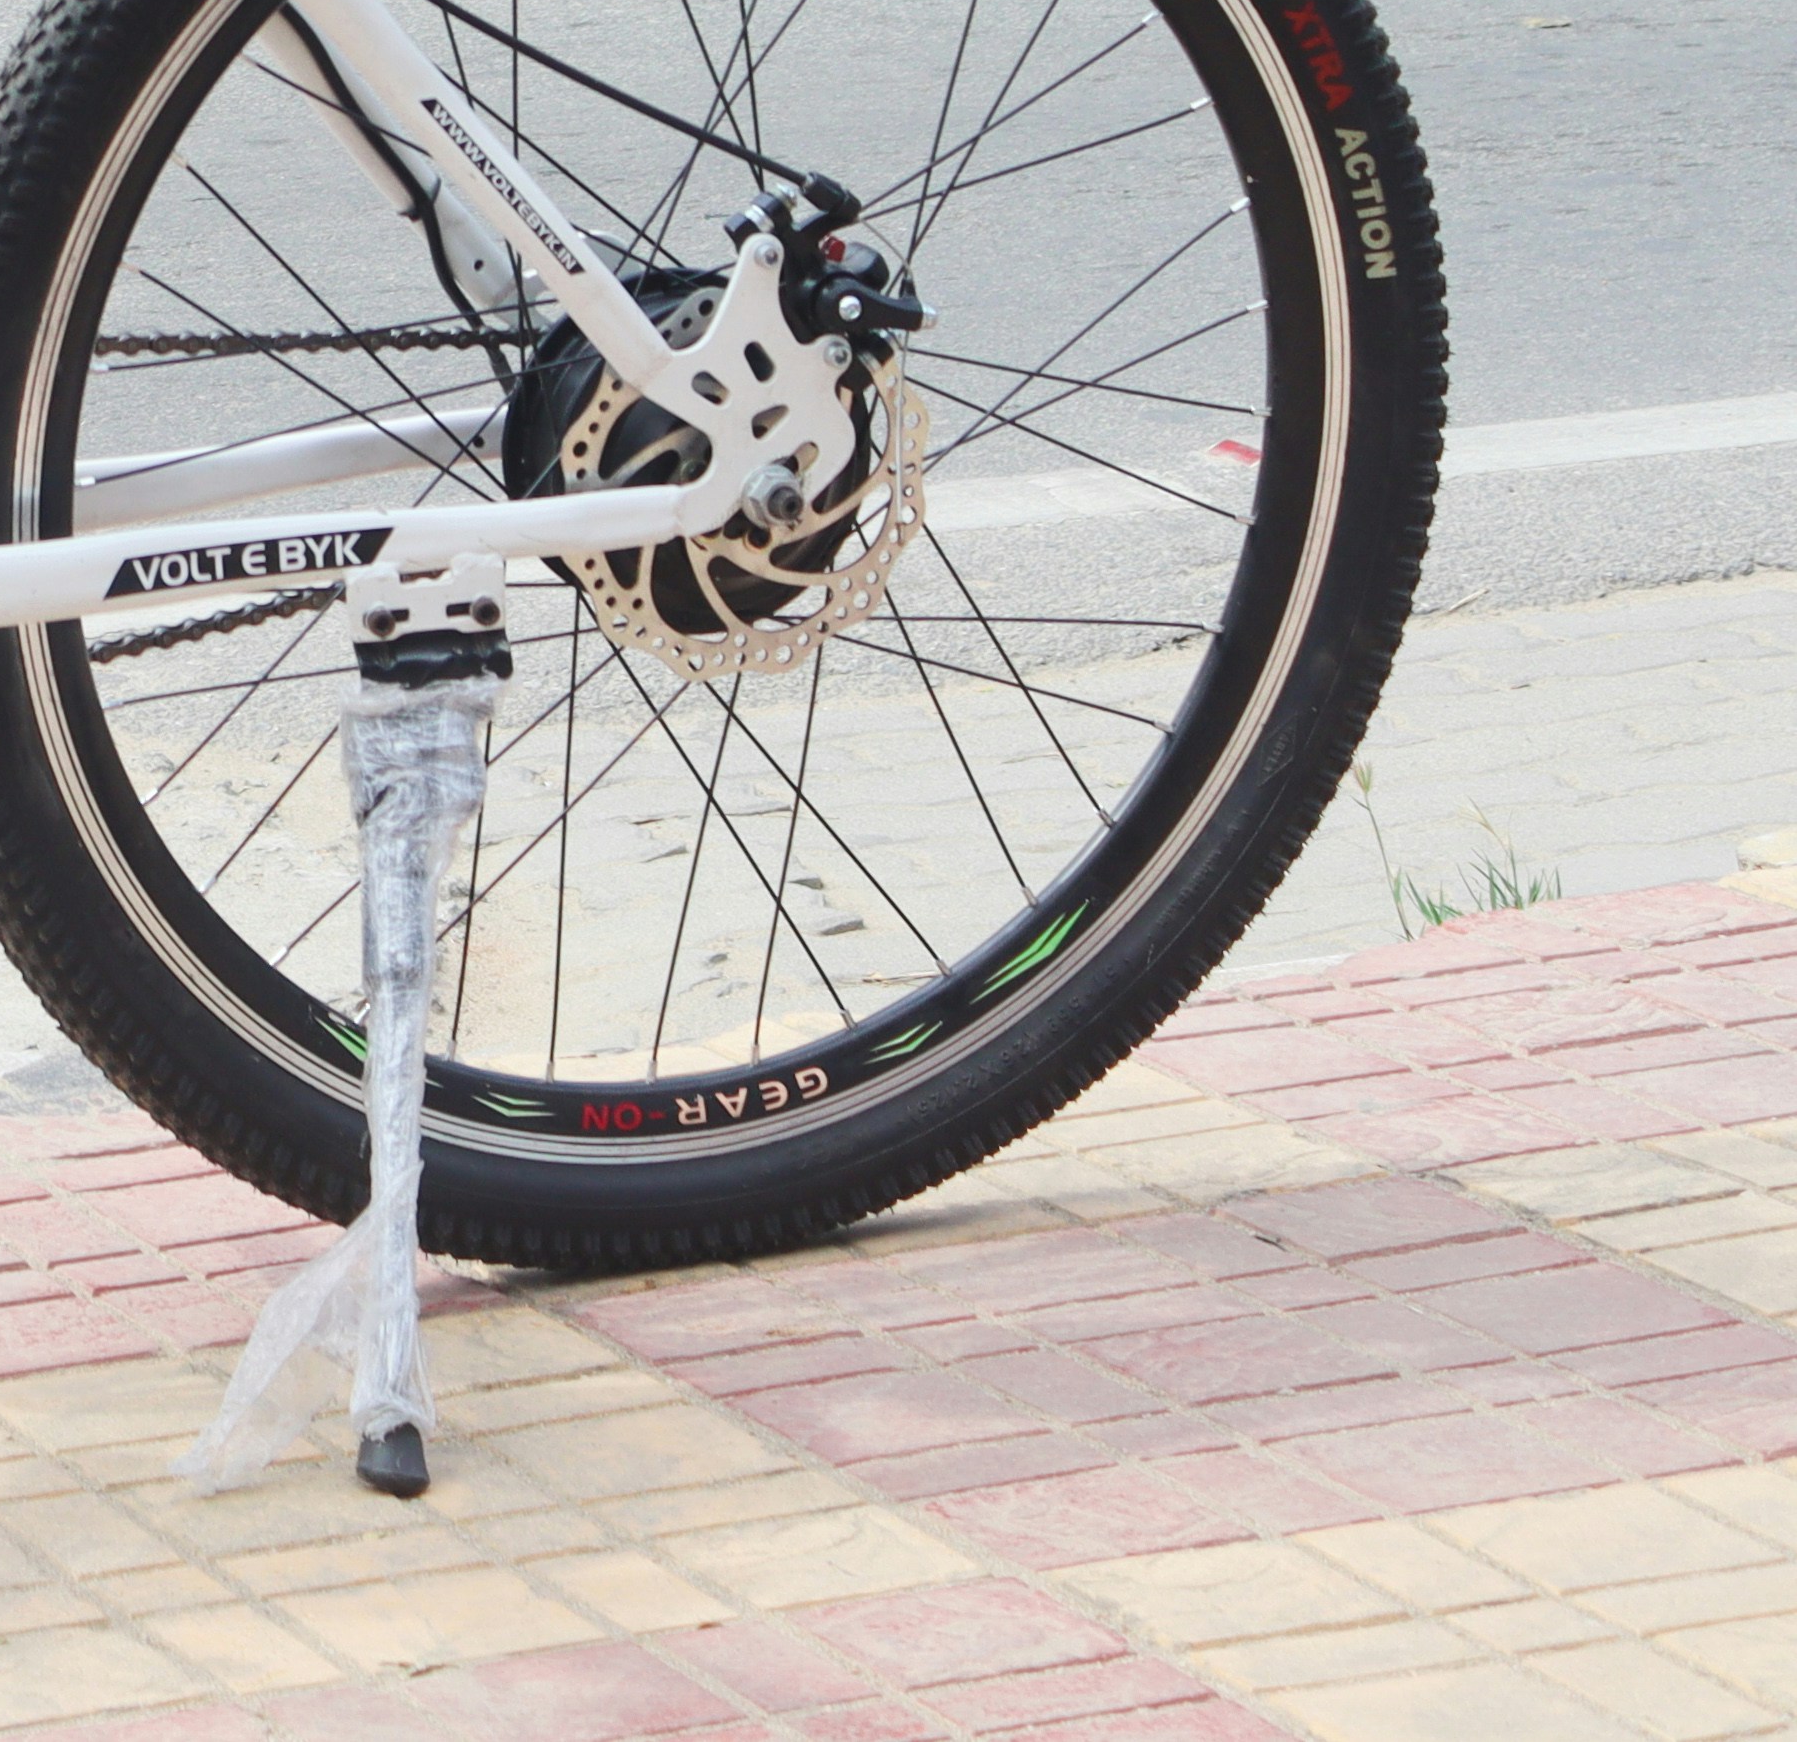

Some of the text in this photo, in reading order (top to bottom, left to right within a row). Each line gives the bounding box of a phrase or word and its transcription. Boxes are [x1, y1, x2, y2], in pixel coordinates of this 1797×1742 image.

[432, 103, 577, 272] WWW.VOLTEBYK.IN
[1284, 0, 1353, 110] XTRA
[1334, 127, 1398, 279] ACTION
[132, 546, 232, 590] VOLT
[278, 532, 362, 572] BYK
